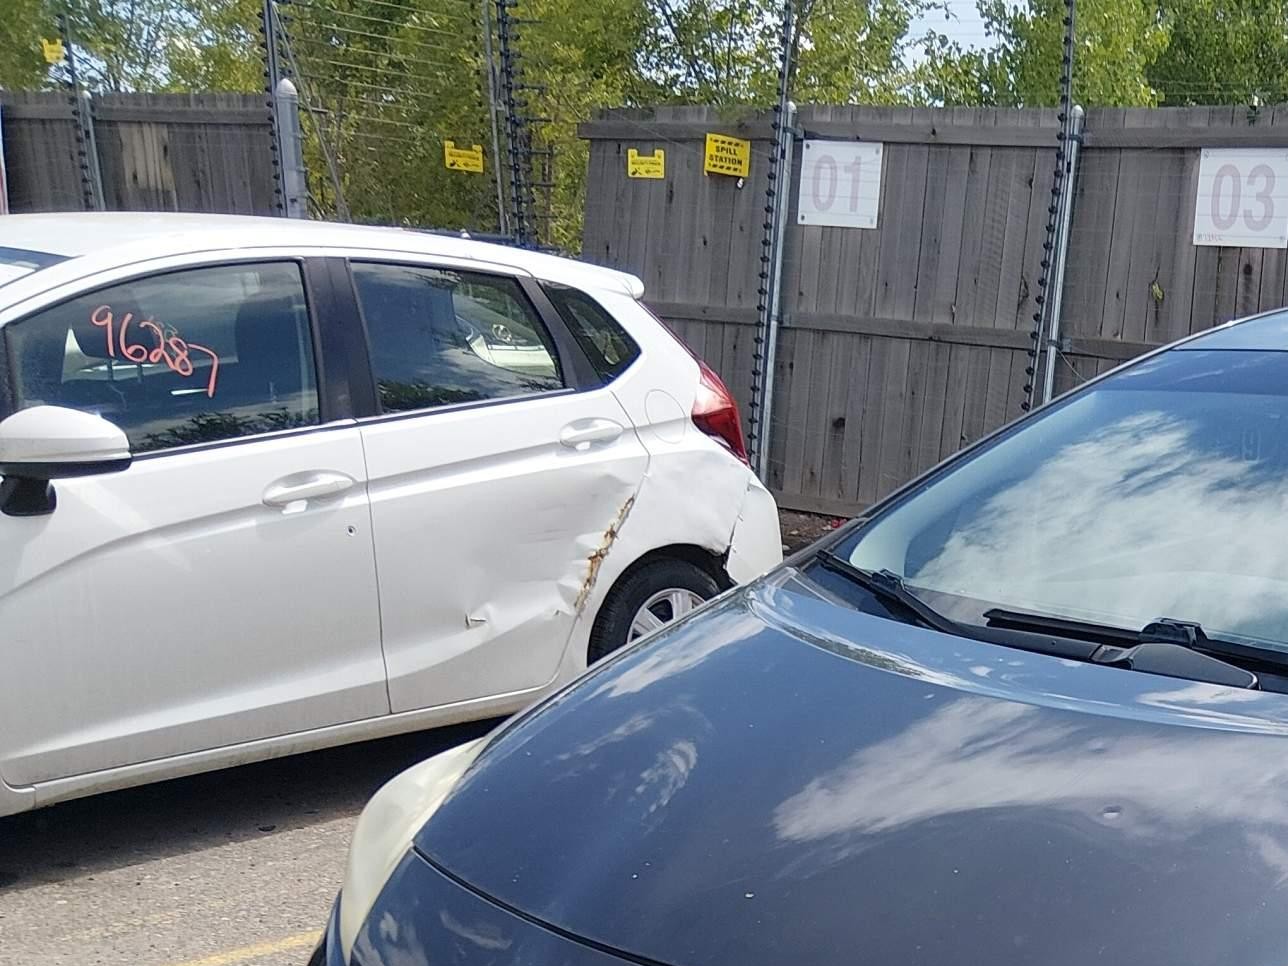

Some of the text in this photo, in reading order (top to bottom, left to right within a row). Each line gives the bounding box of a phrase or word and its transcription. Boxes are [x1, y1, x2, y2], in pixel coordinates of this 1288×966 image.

[708, 153, 743, 167] STATION
[715, 145, 738, 156] SPILL
[812, 154, 862, 213] 01
[1210, 163, 1276, 232] 03
[91, 304, 219, 398] 96287
